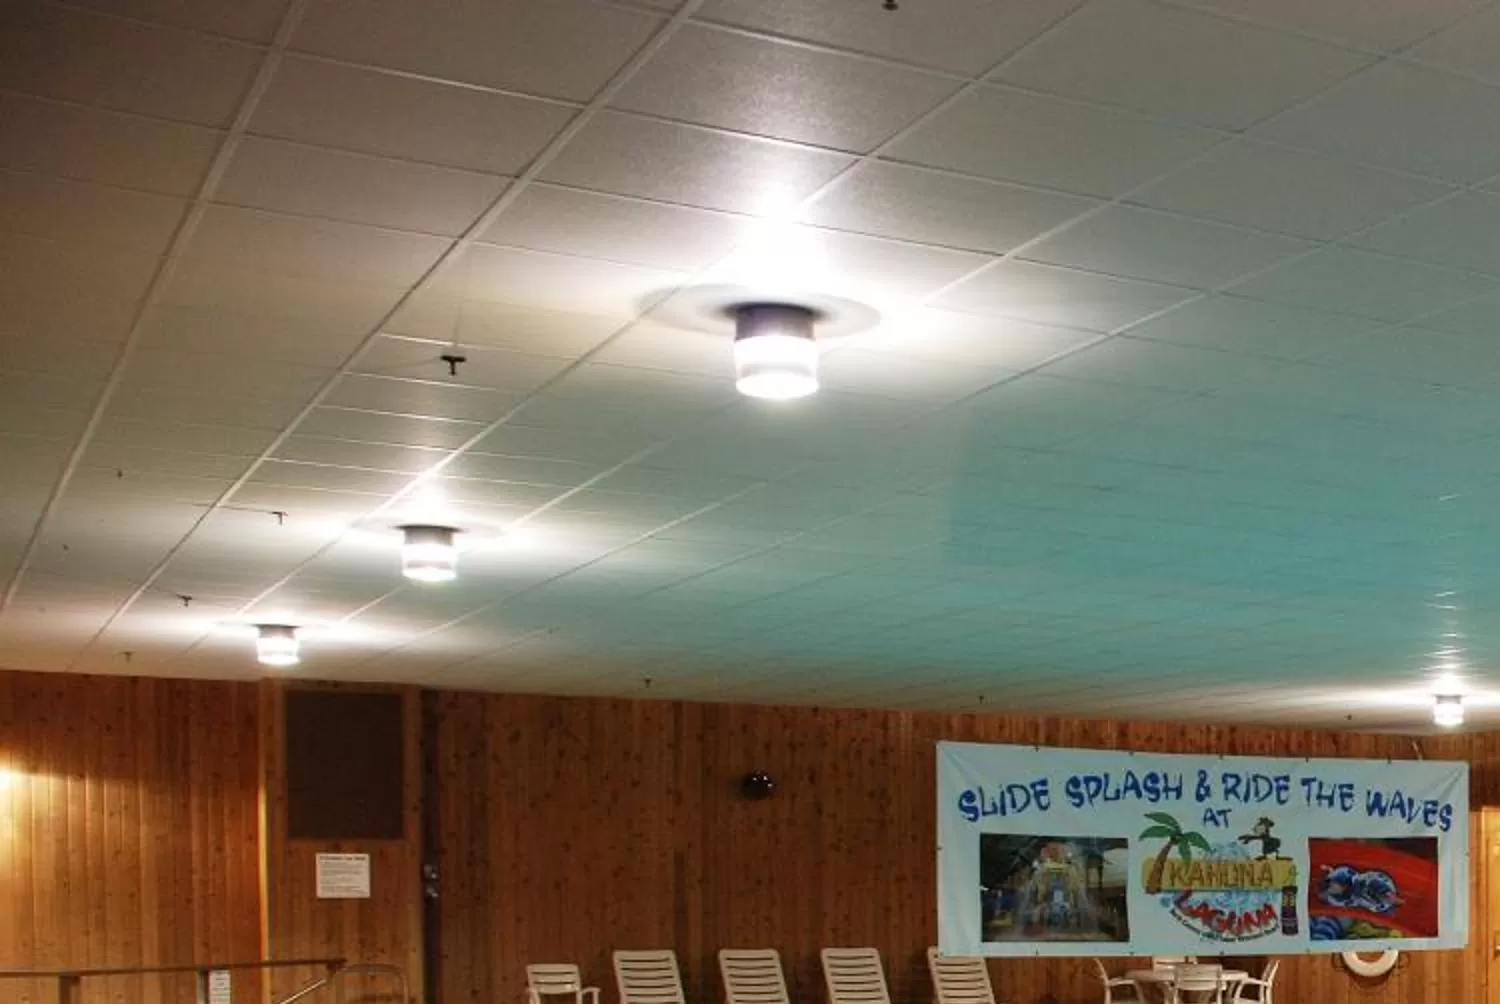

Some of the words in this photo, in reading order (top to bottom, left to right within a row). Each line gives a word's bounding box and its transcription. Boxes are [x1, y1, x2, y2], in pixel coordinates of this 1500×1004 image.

[958, 777, 1050, 822] SLIDE
[1065, 770, 1183, 808] SPLASH
[1194, 769, 1211, 803] &
[1221, 772, 1291, 804] RIDE
[1301, 776, 1354, 812] THE
[1366, 788, 1453, 832] WAVES
[1203, 807, 1232, 828] AT
[1168, 861, 1274, 888] KAHUNA
